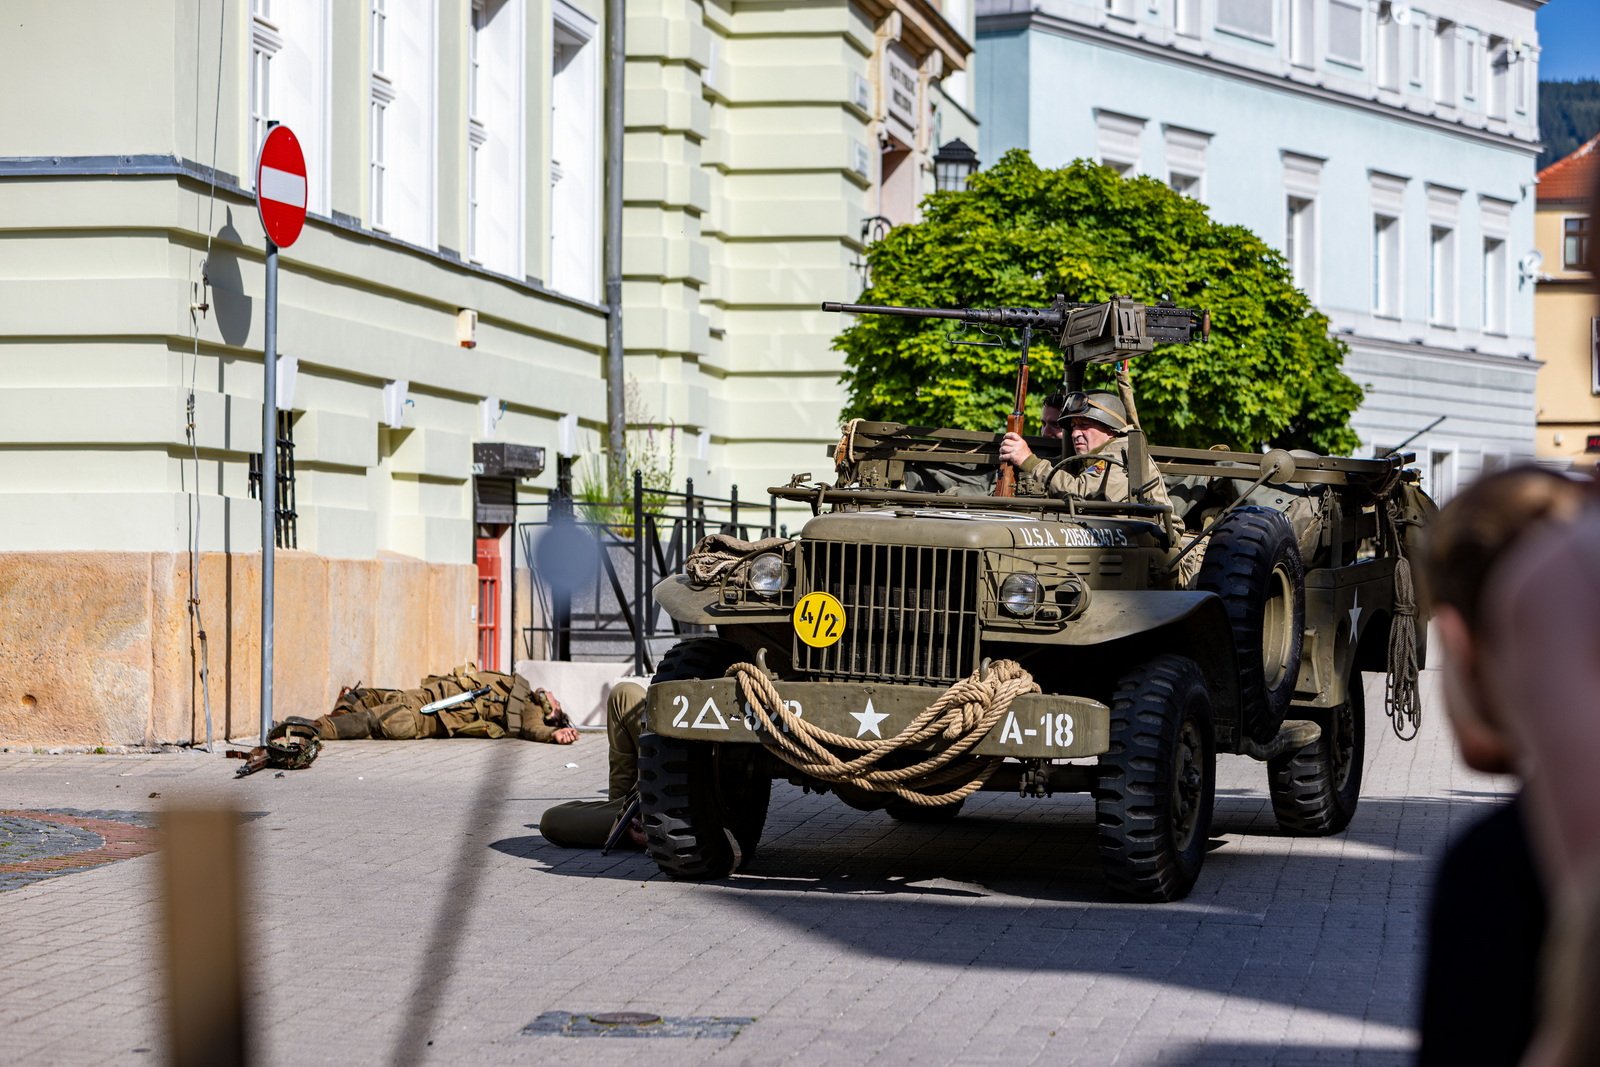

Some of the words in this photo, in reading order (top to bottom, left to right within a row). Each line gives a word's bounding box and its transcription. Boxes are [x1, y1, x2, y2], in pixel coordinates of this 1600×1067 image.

[1020, 527, 1059, 547] U.S.A.
[799, 600, 838, 638] 4/2
[999, 711, 1074, 747] A-18
